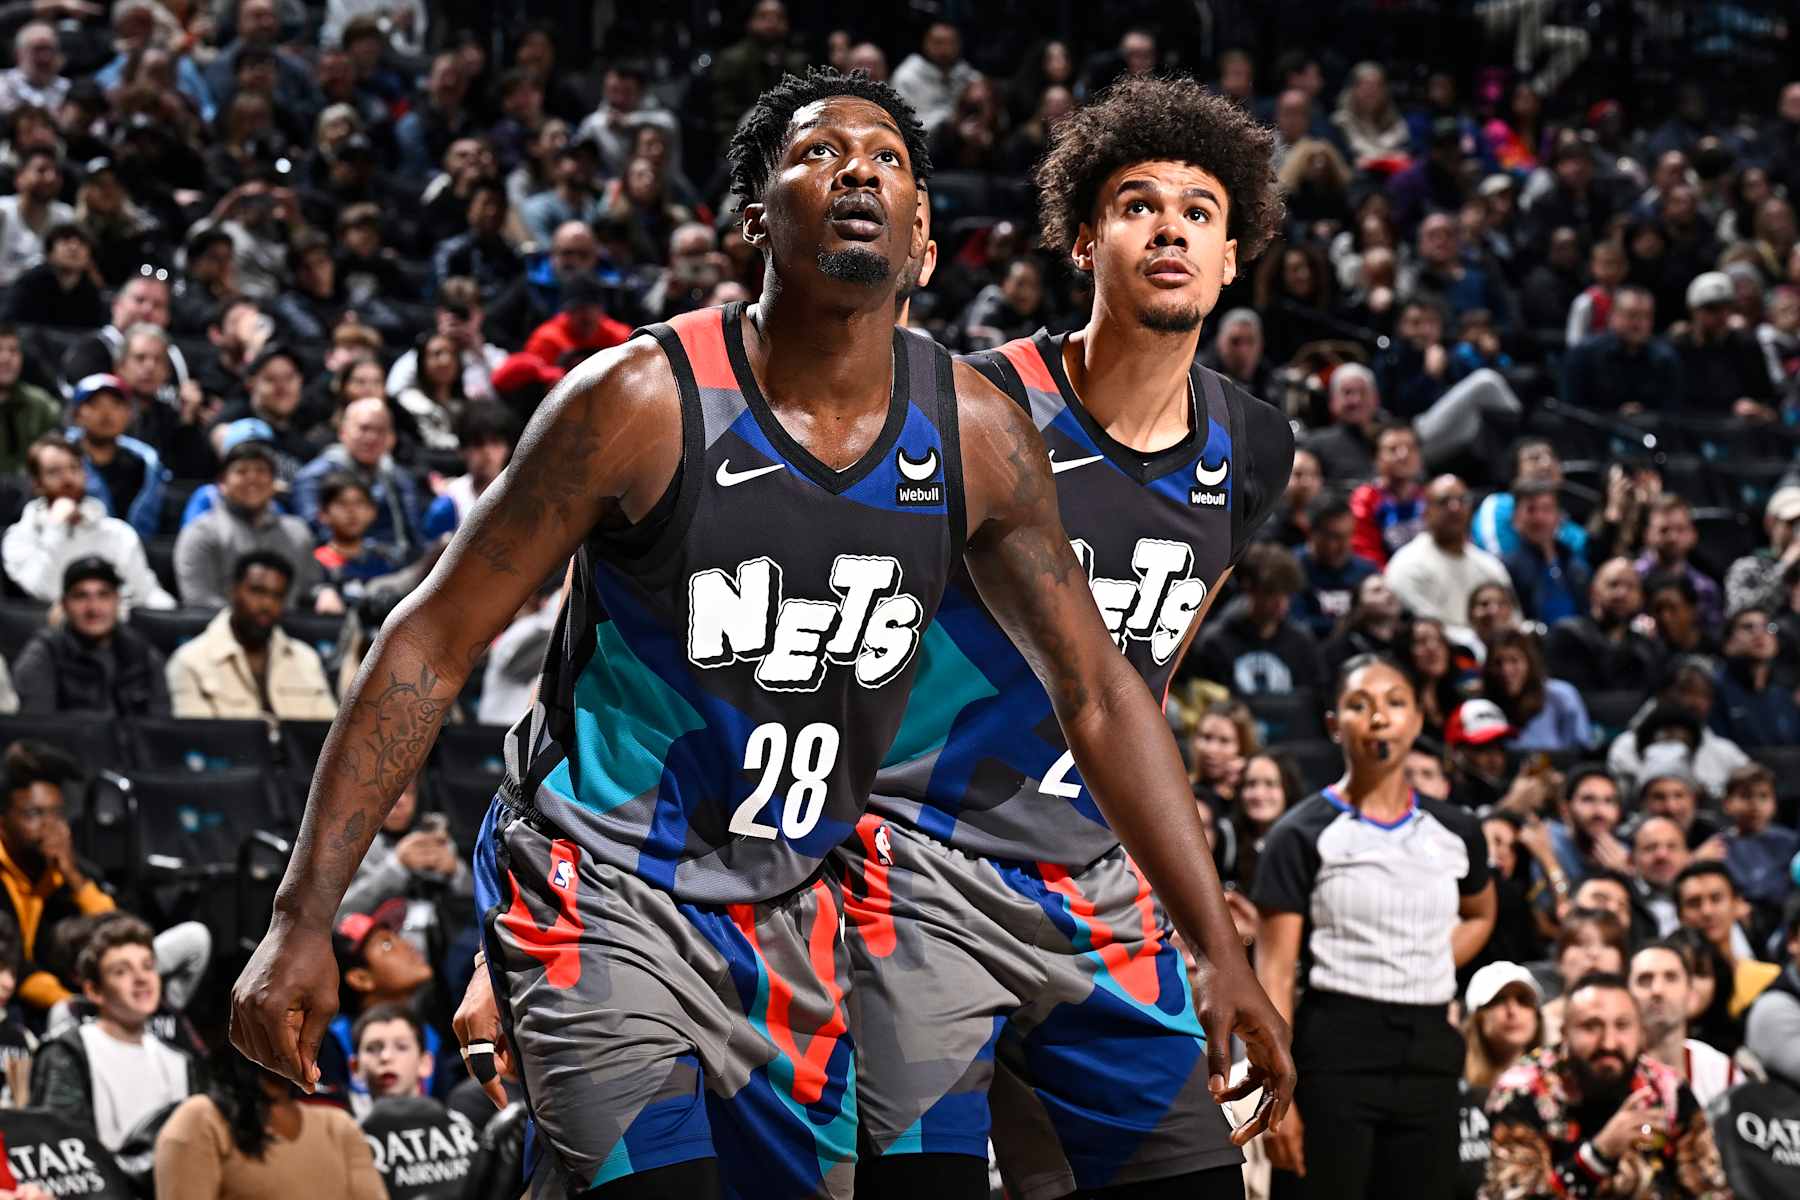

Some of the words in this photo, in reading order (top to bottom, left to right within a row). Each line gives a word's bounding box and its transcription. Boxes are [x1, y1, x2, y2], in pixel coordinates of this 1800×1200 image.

[899, 487, 939, 501] Webull
[1191, 491, 1226, 506] Webull
[688, 554, 924, 693] NETS
[1070, 538, 1207, 666] ETS
[728, 722, 840, 840] 28
